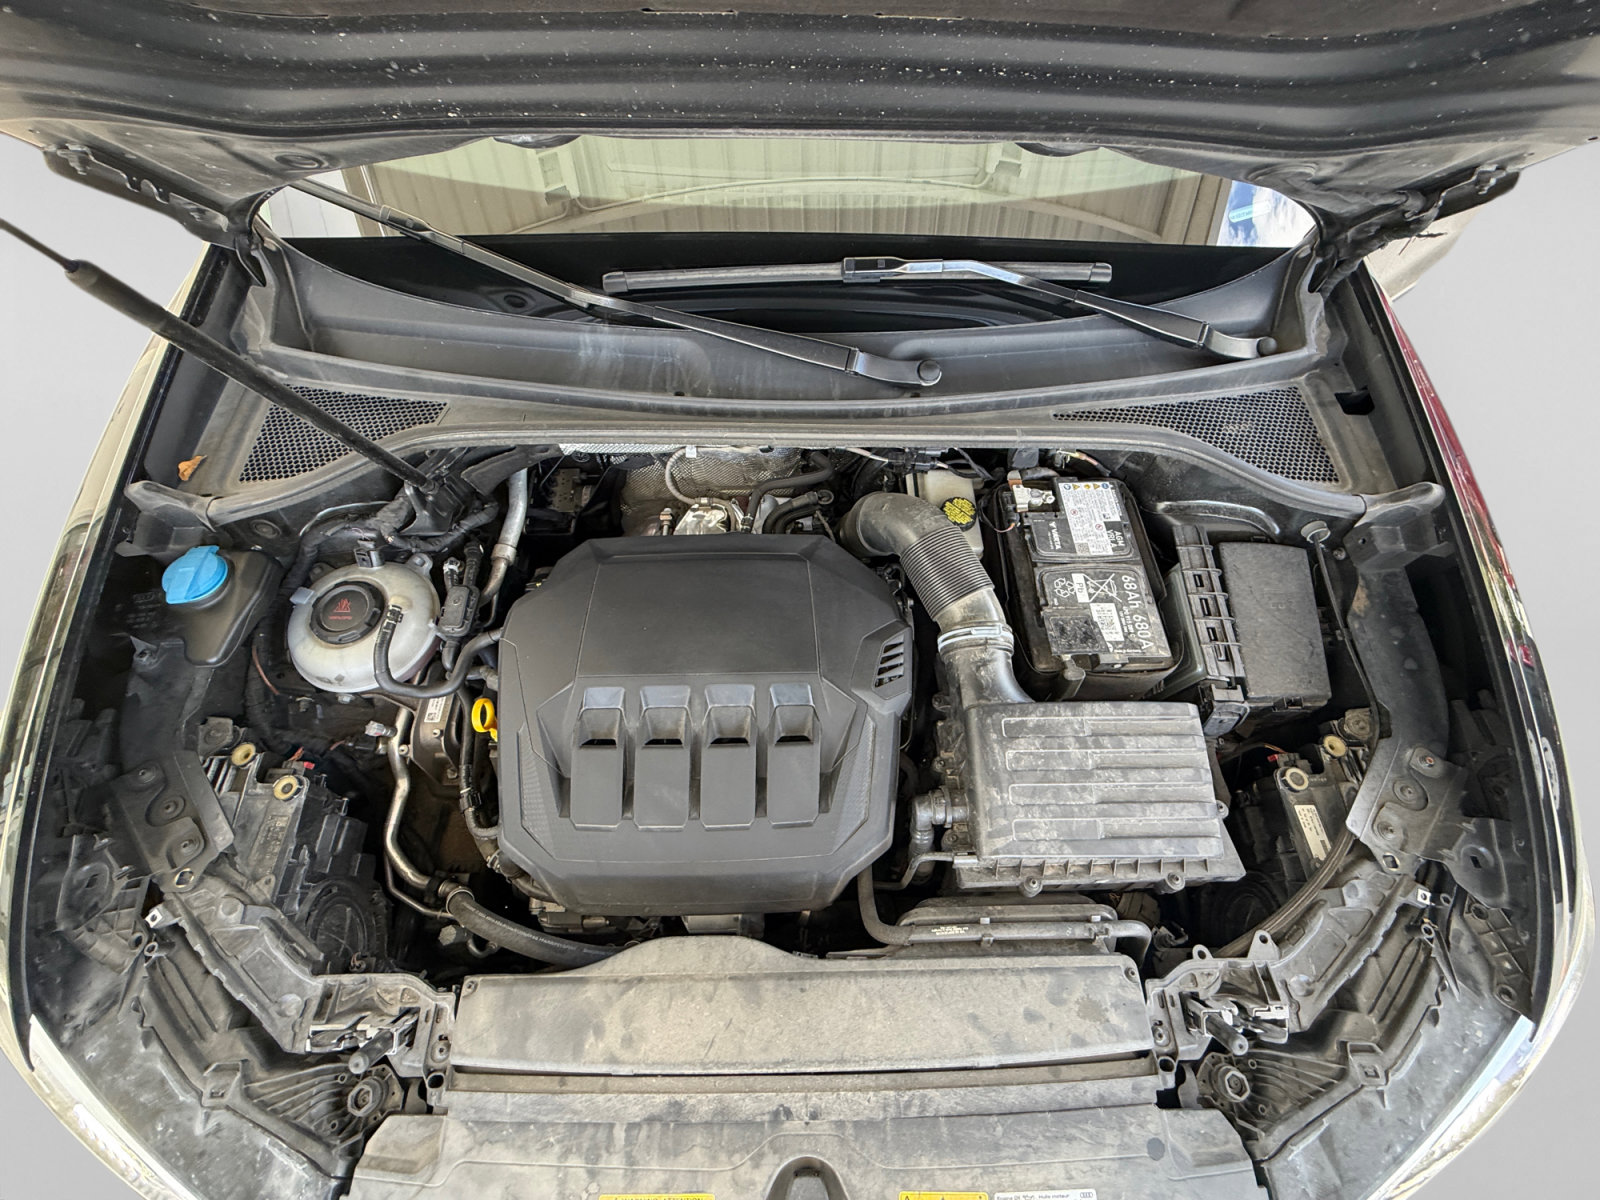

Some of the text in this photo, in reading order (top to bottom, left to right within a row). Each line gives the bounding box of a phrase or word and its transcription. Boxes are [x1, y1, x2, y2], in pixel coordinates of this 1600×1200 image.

[1051, 528, 1062, 550] VARTA
[1114, 530, 1126, 547] AGM
[1075, 582, 1084, 593] Pb
[1121, 575, 1155, 650] 68Ah 680A
